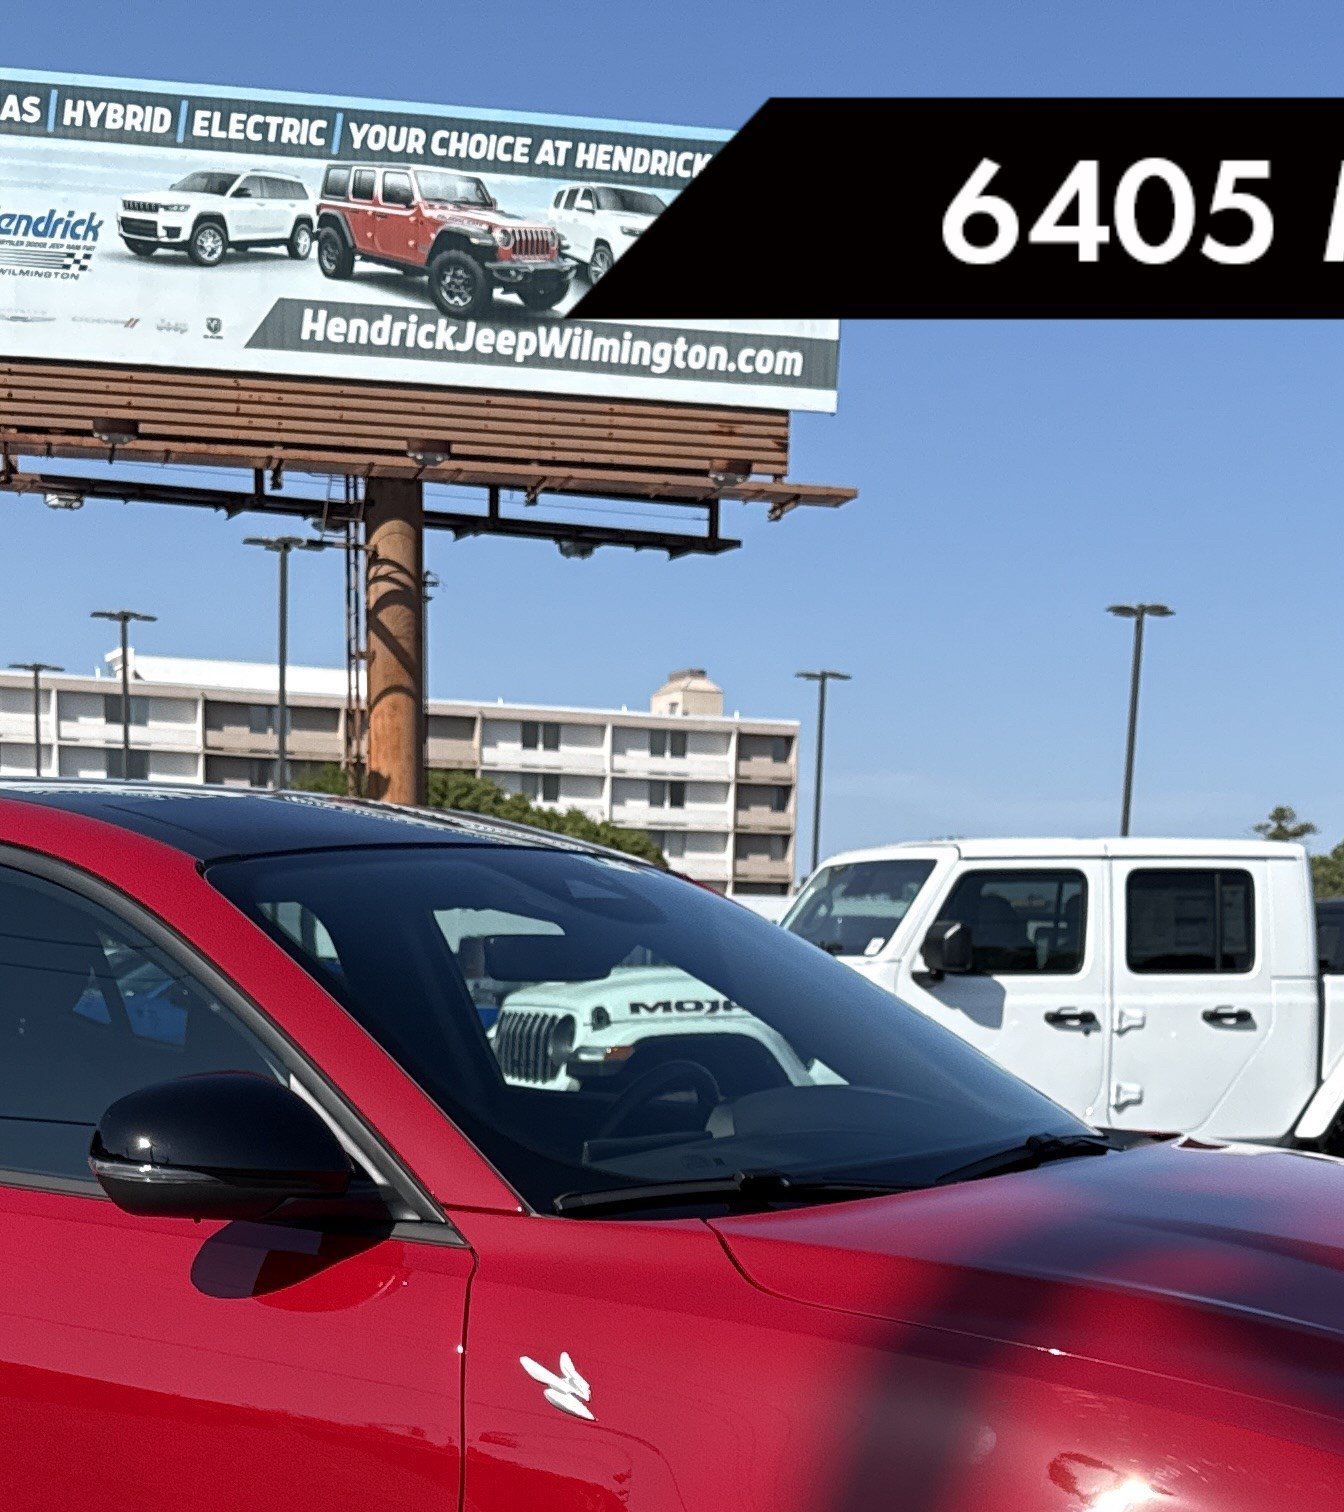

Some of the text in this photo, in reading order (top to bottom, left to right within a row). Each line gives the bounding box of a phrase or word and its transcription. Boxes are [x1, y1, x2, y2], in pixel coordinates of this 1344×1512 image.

[62, 99, 172, 134] HYBRID
[192, 110, 327, 146] ELECTRIC
[349, 122, 425, 155] YOUR
[431, 130, 529, 164] CHOICE
[536, 139, 574, 167] AT
[300, 308, 804, 377] HendrickJeepWilmington.com
